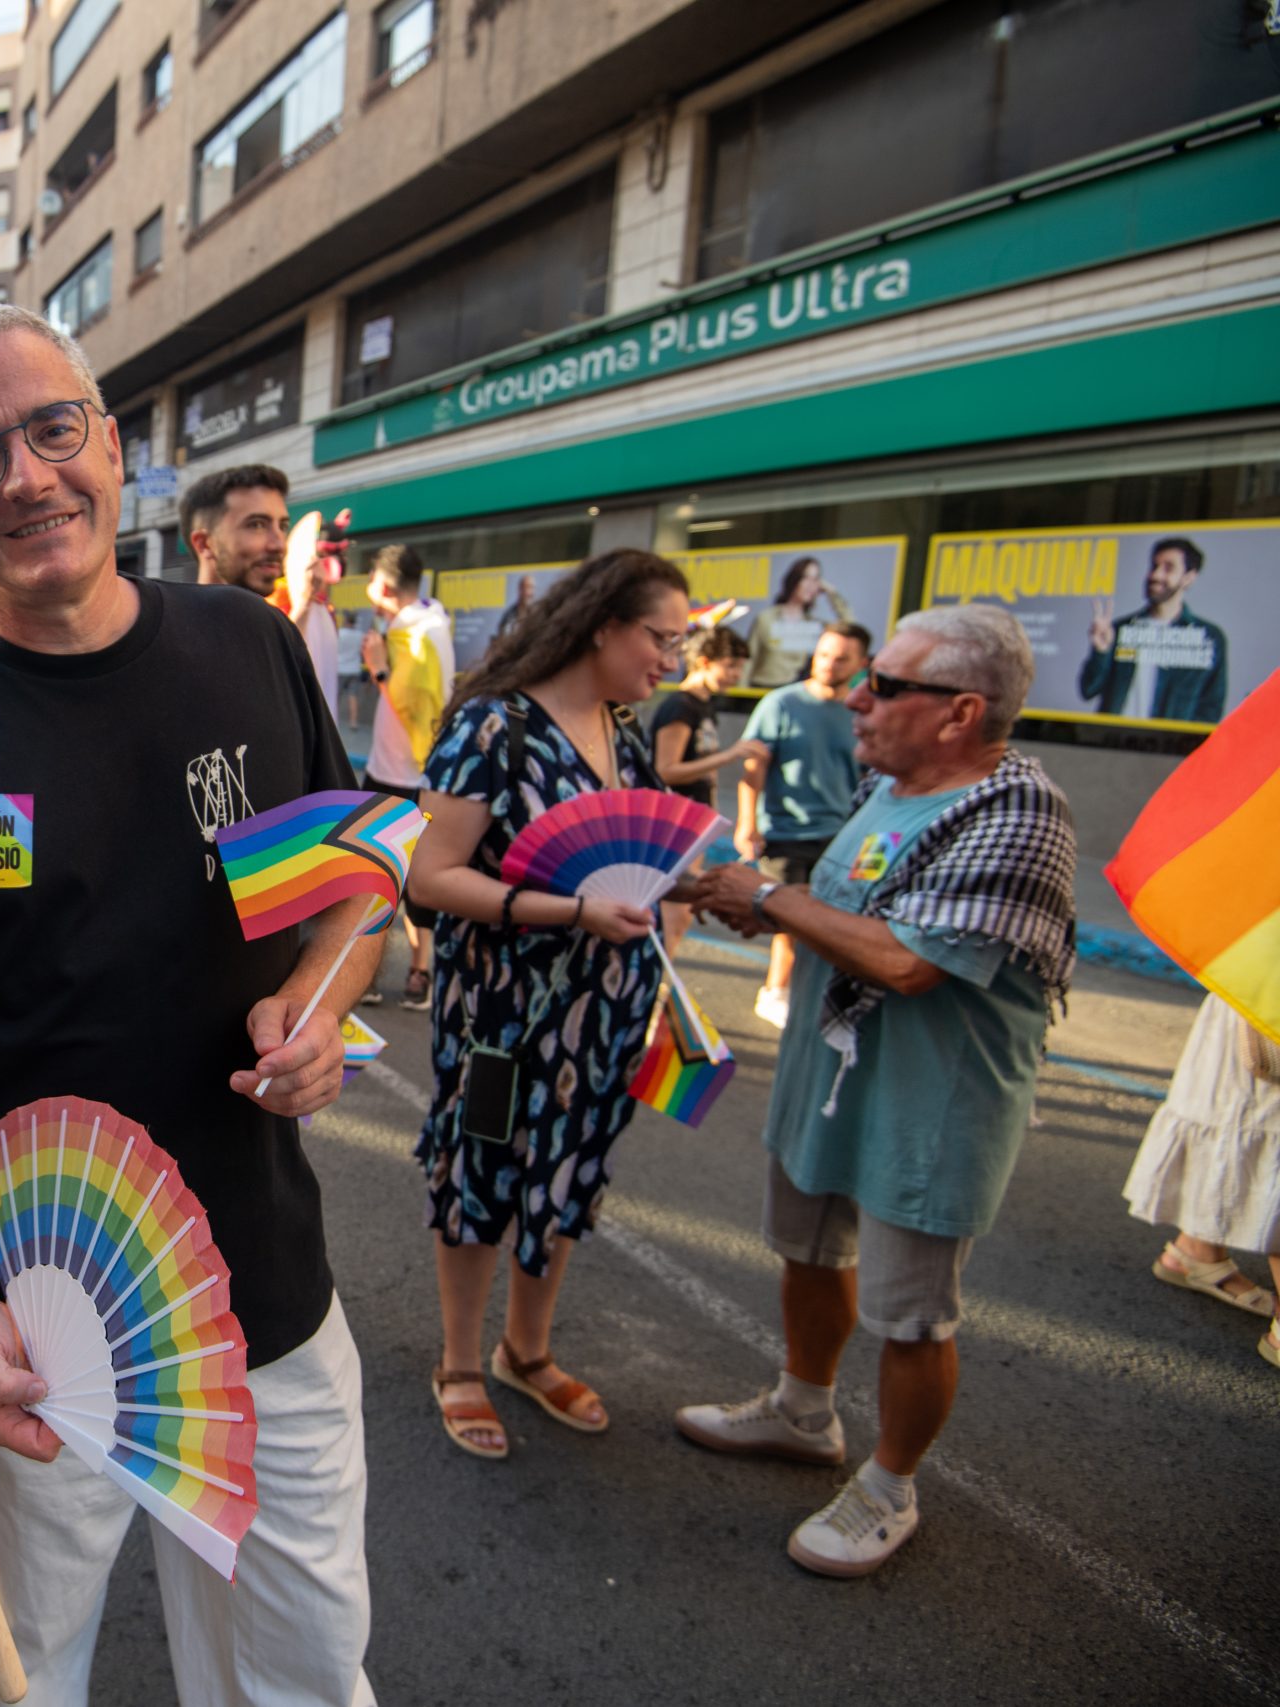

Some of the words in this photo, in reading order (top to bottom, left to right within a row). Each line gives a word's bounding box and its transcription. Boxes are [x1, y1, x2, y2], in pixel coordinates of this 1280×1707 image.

[458, 337, 640, 415] Groupama
[648, 302, 758, 365] Plus
[767, 258, 911, 330] Ultra
